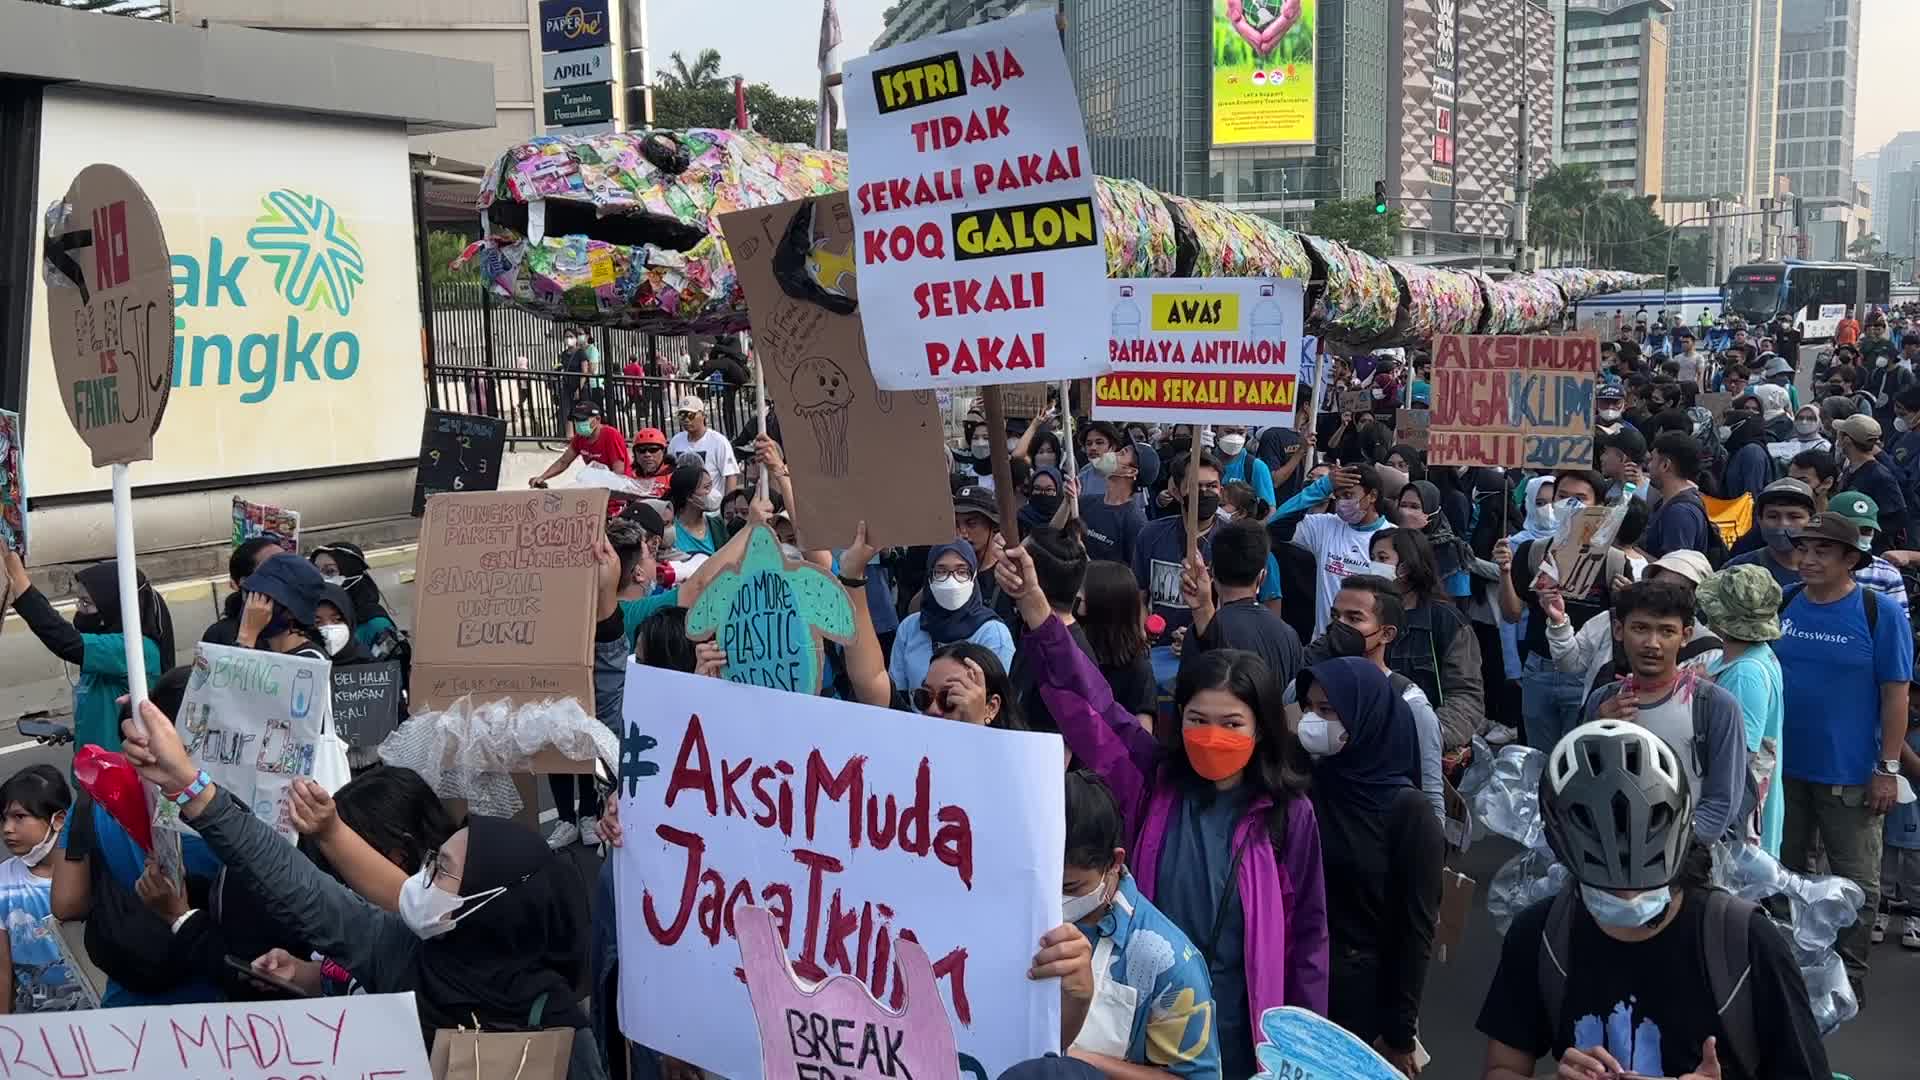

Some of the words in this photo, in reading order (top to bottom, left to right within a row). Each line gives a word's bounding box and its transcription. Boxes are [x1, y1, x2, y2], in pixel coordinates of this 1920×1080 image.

[546, 17, 581, 33] PAPER
[553, 62, 593, 80] APRIL
[879, 59, 958, 107] ISTRI
[970, 47, 1025, 90] AJA
[553, 105, 602, 119] Foundation
[911, 104, 1011, 152] TIDAK
[856, 168, 964, 215] SEKALI
[972, 146, 1082, 195] PAKAI
[92, 199, 131, 291] NO
[863, 222, 945, 265] KOQ
[957, 203, 1093, 255] GALON
[171, 236, 249, 307] ak
[913, 271, 1045, 320] SEKALI
[1167, 299, 1222, 325] AWAS
[100, 350, 119, 374] IS
[174, 315, 361, 405] ingko
[925, 332, 1045, 376] PAKAI
[1109, 339, 1185, 363] BAHAYA
[1190, 340, 1287, 365] ANTIMON
[1096, 377, 1157, 401] GALON
[1162, 379, 1226, 404] SEKALI
[1233, 380, 1295, 405] PAKAI
[1526, 435, 1593, 467] 2022
[453, 476, 465, 490] 6
[446, 499, 539, 524] BUNGKUS
[445, 525, 514, 546] PAKET
[457, 596, 542, 618] UNTUK
[728, 583, 751, 621] NO
[753, 569, 793, 611] MORE
[456, 620, 537, 648] BUMI
[724, 610, 801, 668] PLASTIC
[212, 655, 281, 696] BRING
[359, 671, 392, 685] HALAL
[334, 688, 385, 702] KEMASAN
[170, 1008, 347, 1070] MADLY
[786, 1008, 914, 1080] BREAK
